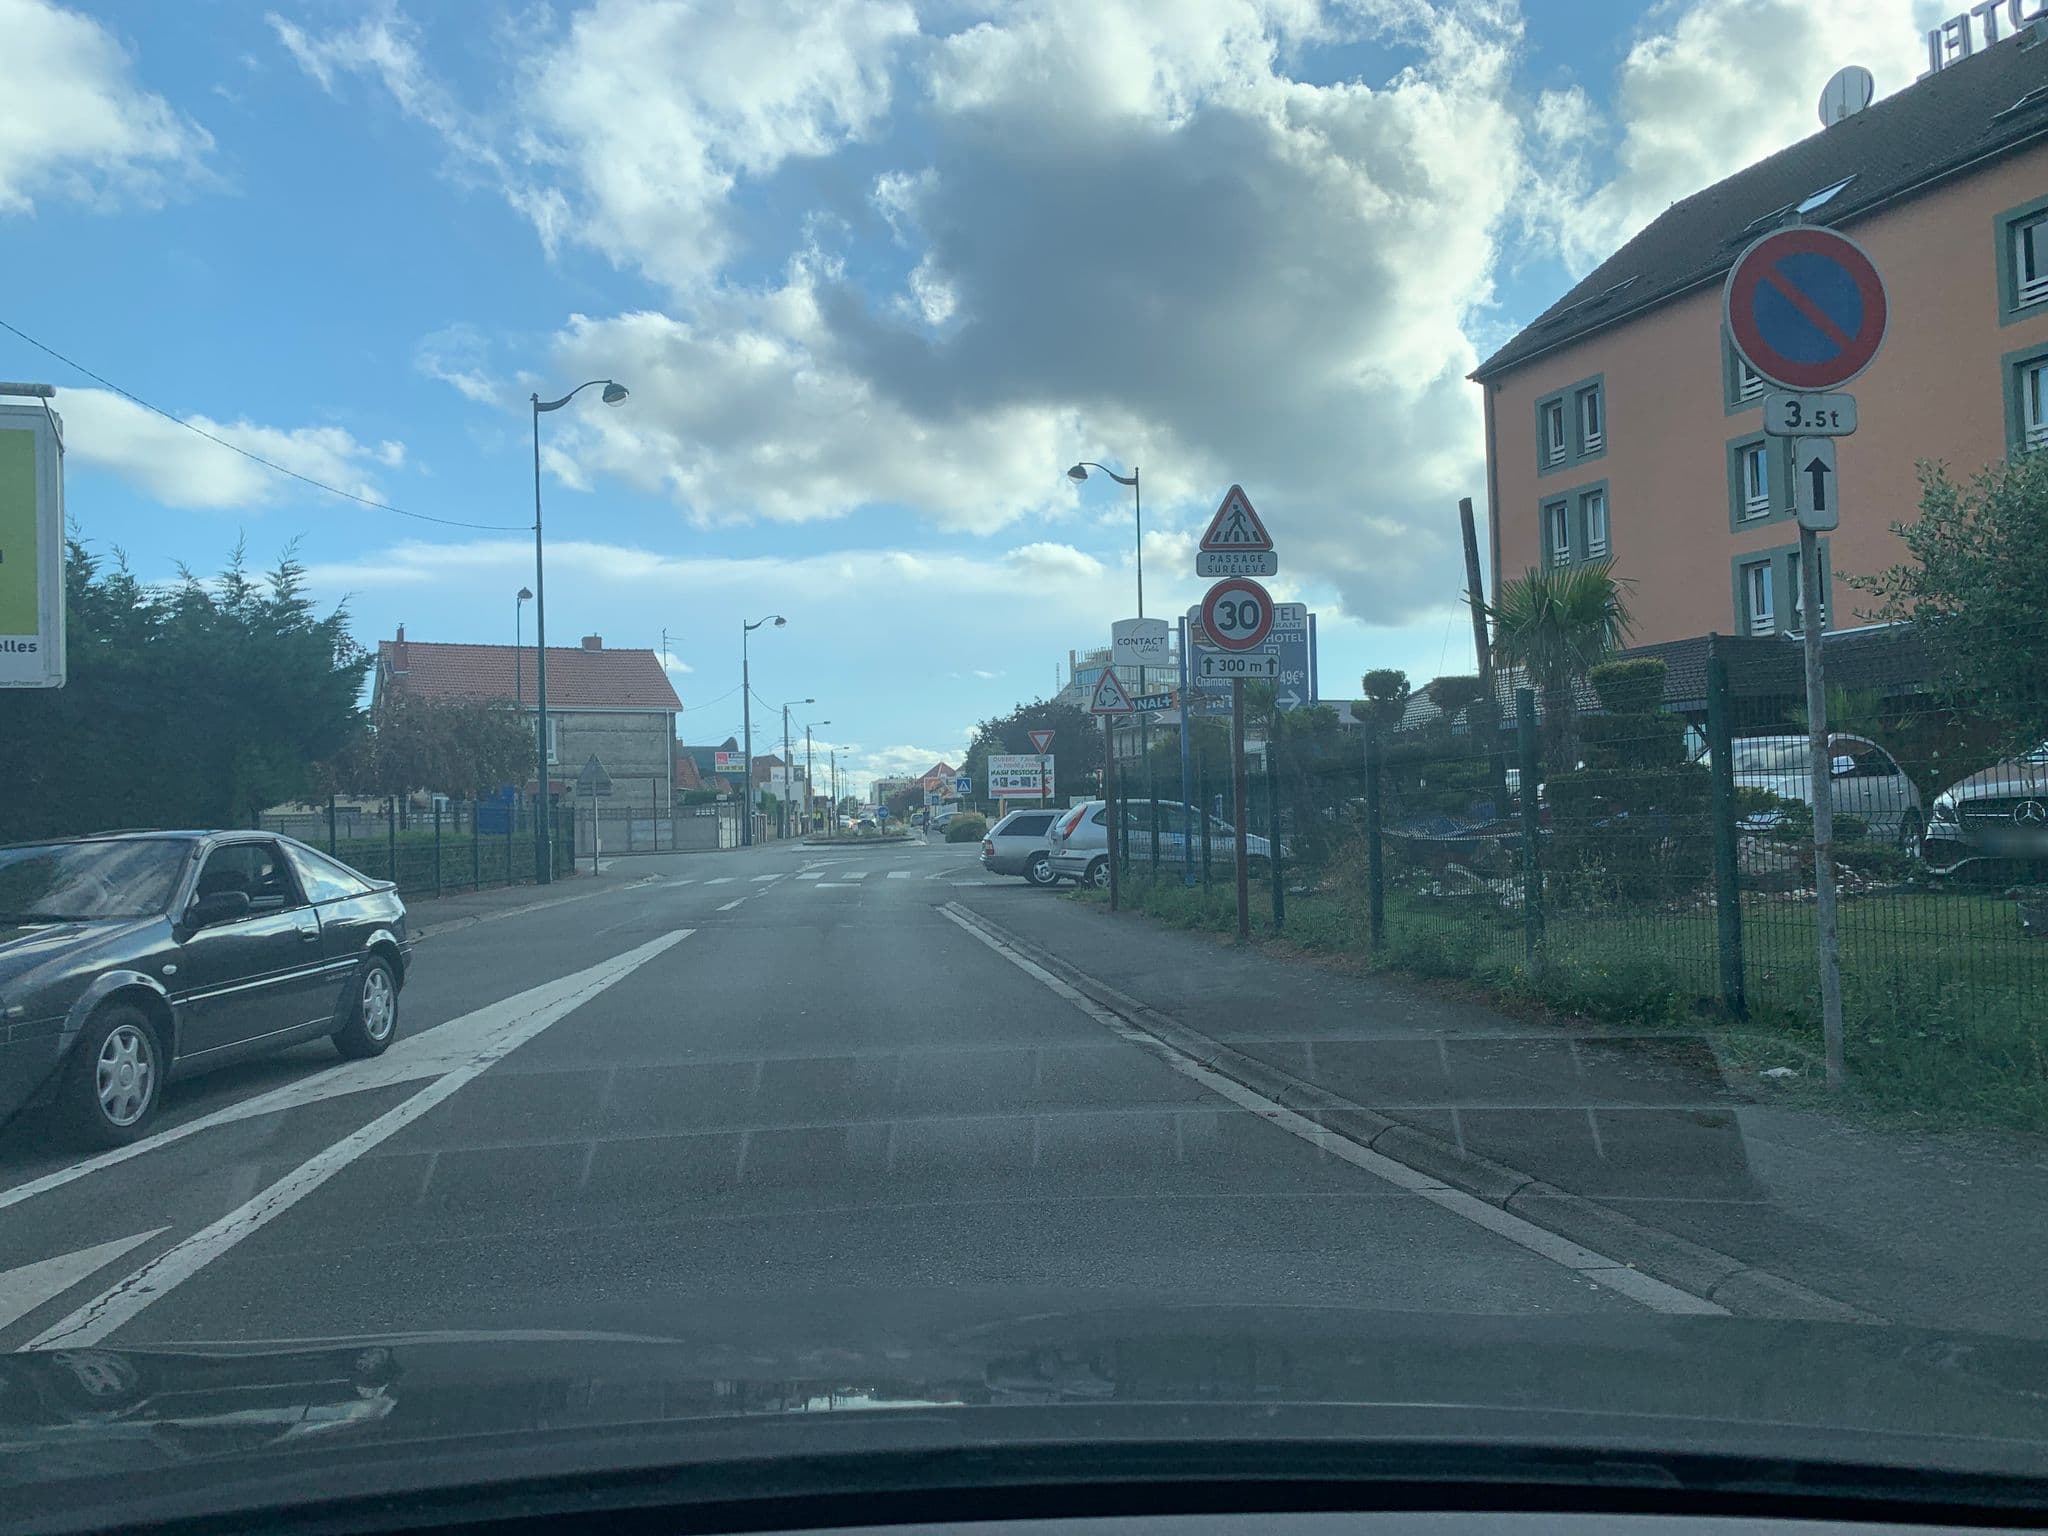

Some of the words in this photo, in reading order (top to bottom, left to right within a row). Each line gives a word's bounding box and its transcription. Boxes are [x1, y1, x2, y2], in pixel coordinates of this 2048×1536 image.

[1210, 554, 1264, 563] PASSAGE
[1207, 563, 1267, 573] SURÉLEVÉ
[1218, 600, 1260, 631] 30
[1117, 637, 1165, 646] CONTACT
[1266, 633, 1304, 643] HOTEL
[1218, 659, 1246, 672] 300
[1249, 662, 1262, 673] m
